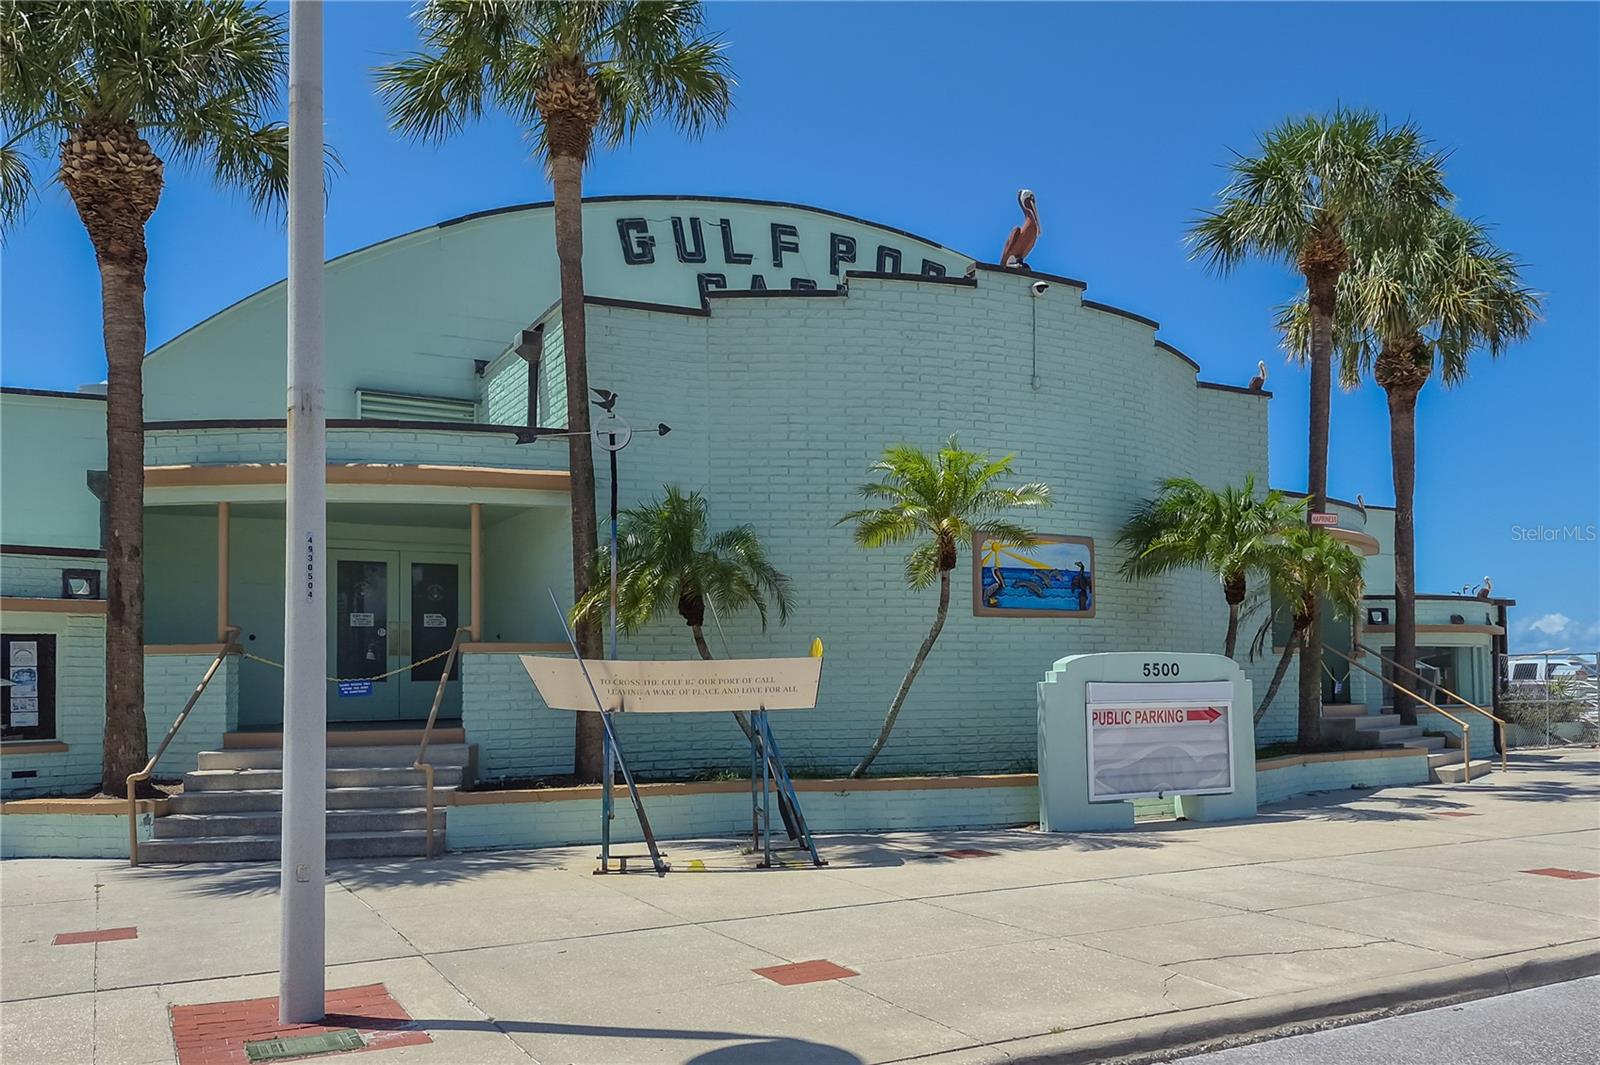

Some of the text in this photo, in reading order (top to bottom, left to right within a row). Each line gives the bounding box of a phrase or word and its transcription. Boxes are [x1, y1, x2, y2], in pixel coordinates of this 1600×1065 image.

[1143, 663, 1180, 677] 5500
[755, 676, 776, 684] CALL
[607, 688, 642, 696] LEAVING
[653, 688, 676, 696] WAKE
[678, 688, 689, 696] OF
[1092, 709, 1184, 726] PUBLIC PARKING
